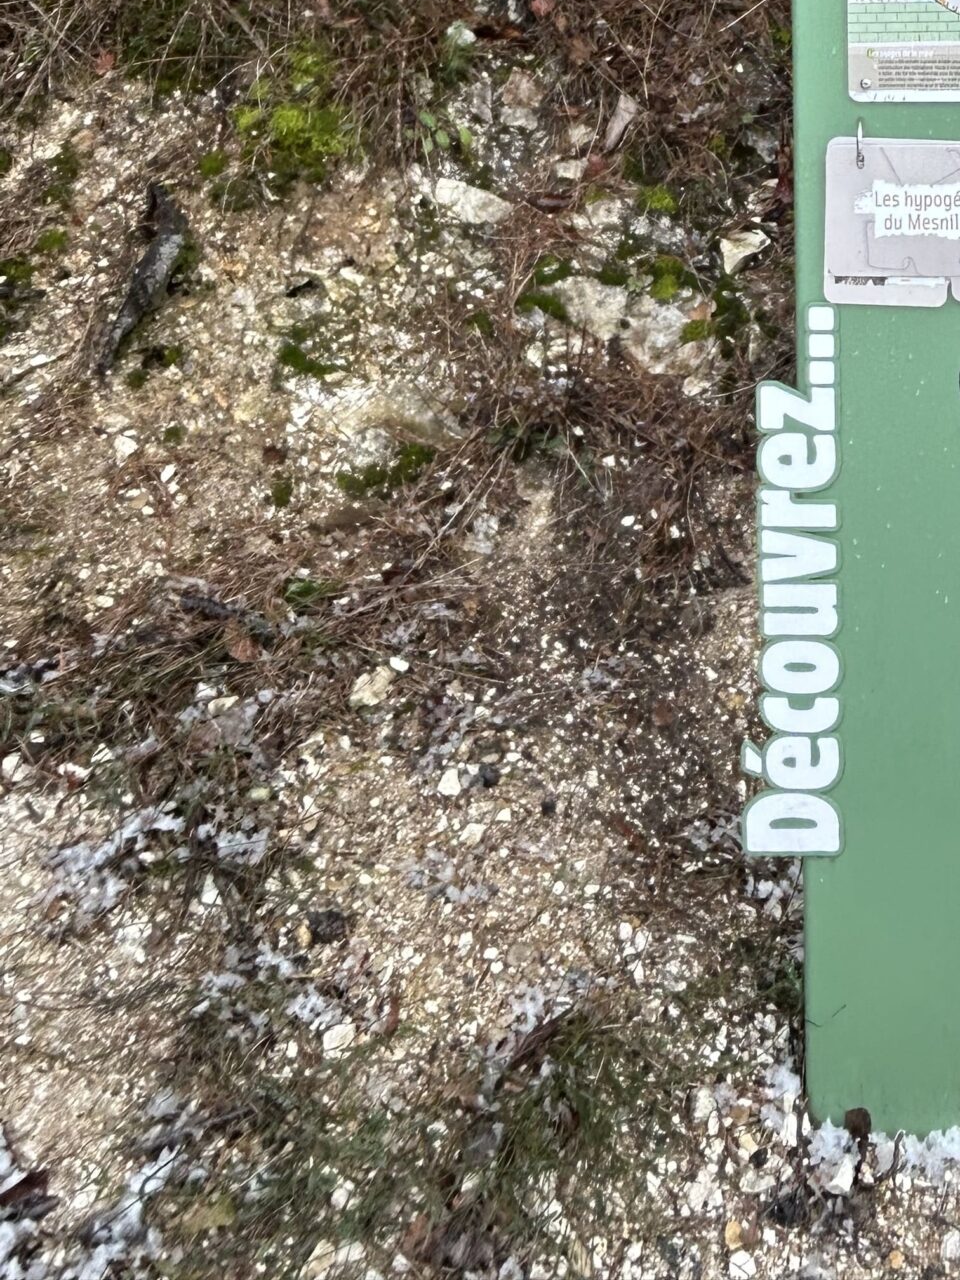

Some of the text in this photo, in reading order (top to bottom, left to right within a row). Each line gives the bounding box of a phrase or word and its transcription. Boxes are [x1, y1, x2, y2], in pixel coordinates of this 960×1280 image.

[874, 191, 900, 207] Les
[884, 214, 903, 230] du
[747, 306, 840, 853] Découvrez...
